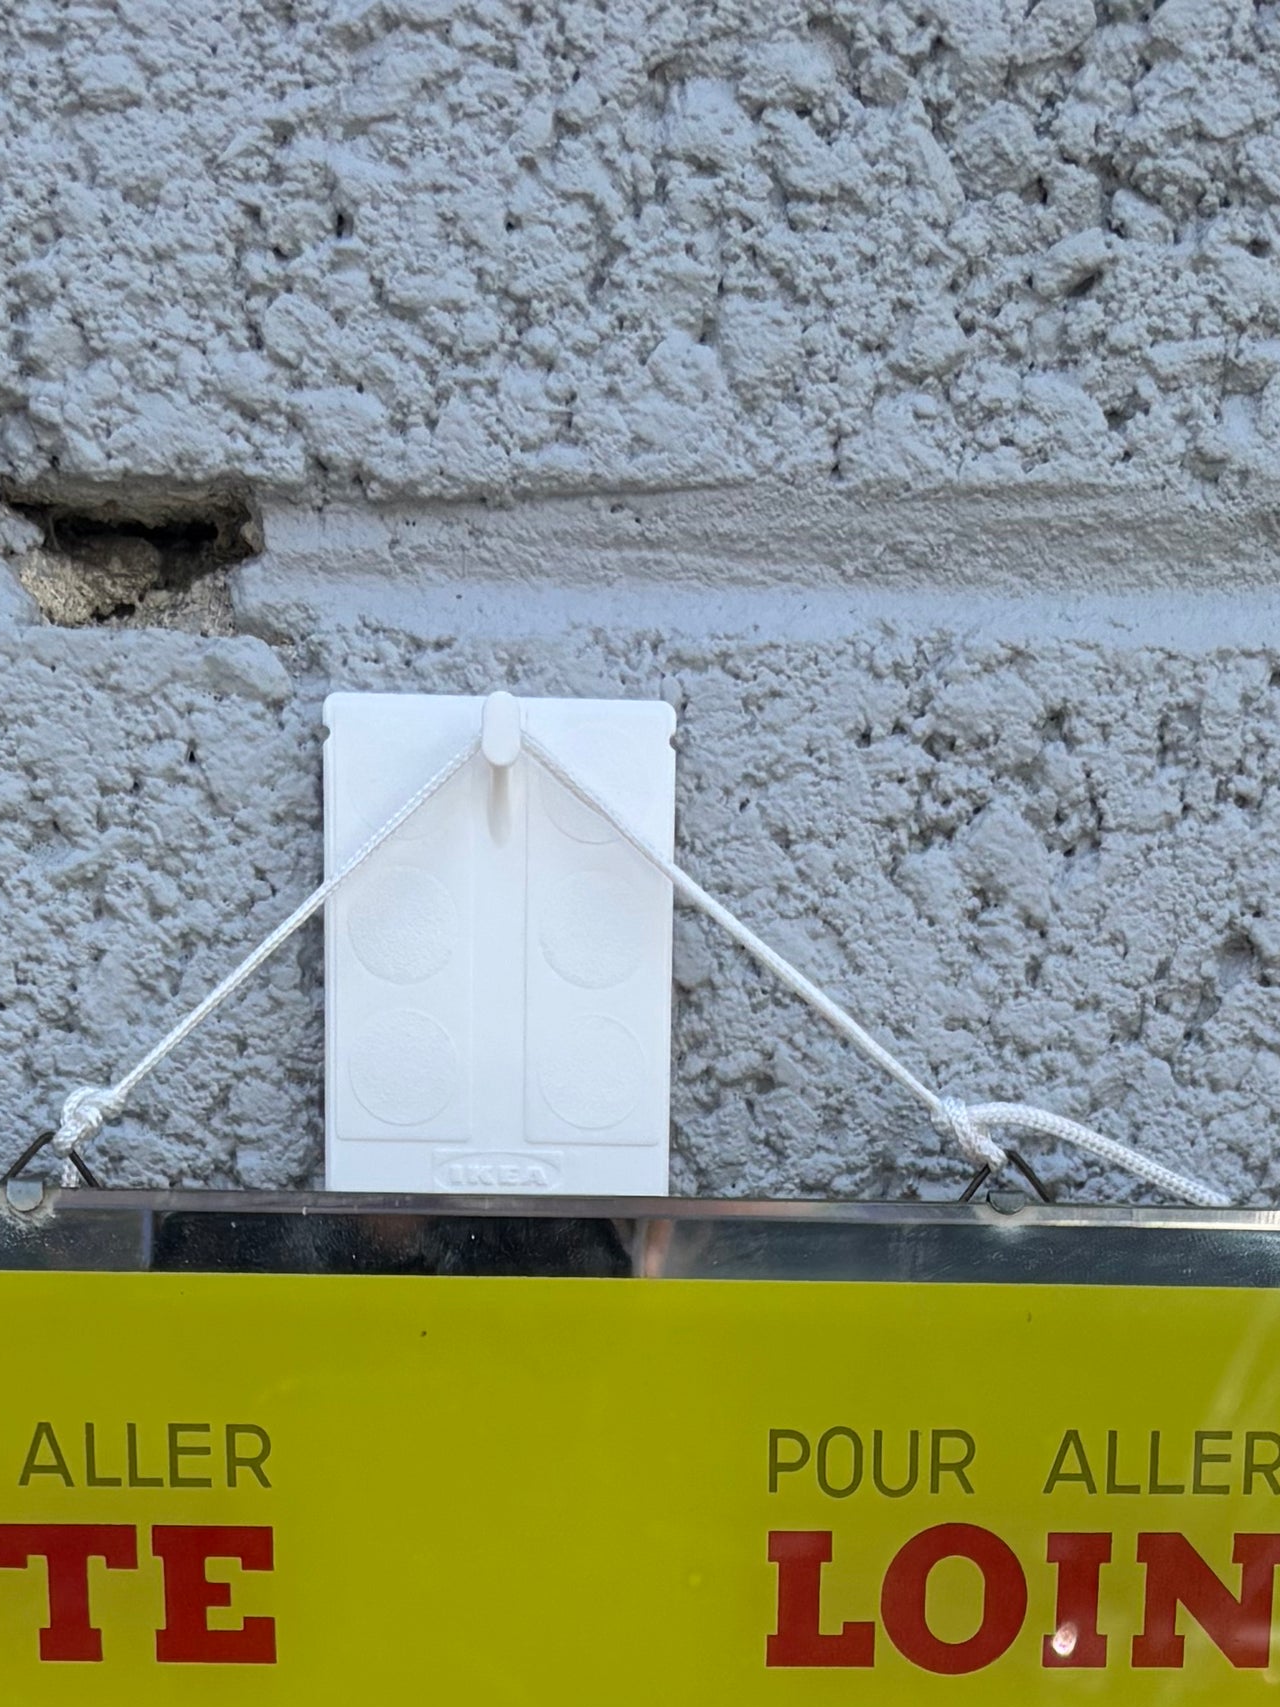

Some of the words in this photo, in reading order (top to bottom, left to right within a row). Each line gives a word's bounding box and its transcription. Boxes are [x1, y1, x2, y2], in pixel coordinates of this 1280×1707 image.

[448, 1164, 549, 1186] IKEA
[18, 1421, 272, 1488] ALLER
[768, 1426, 976, 1498] POUR
